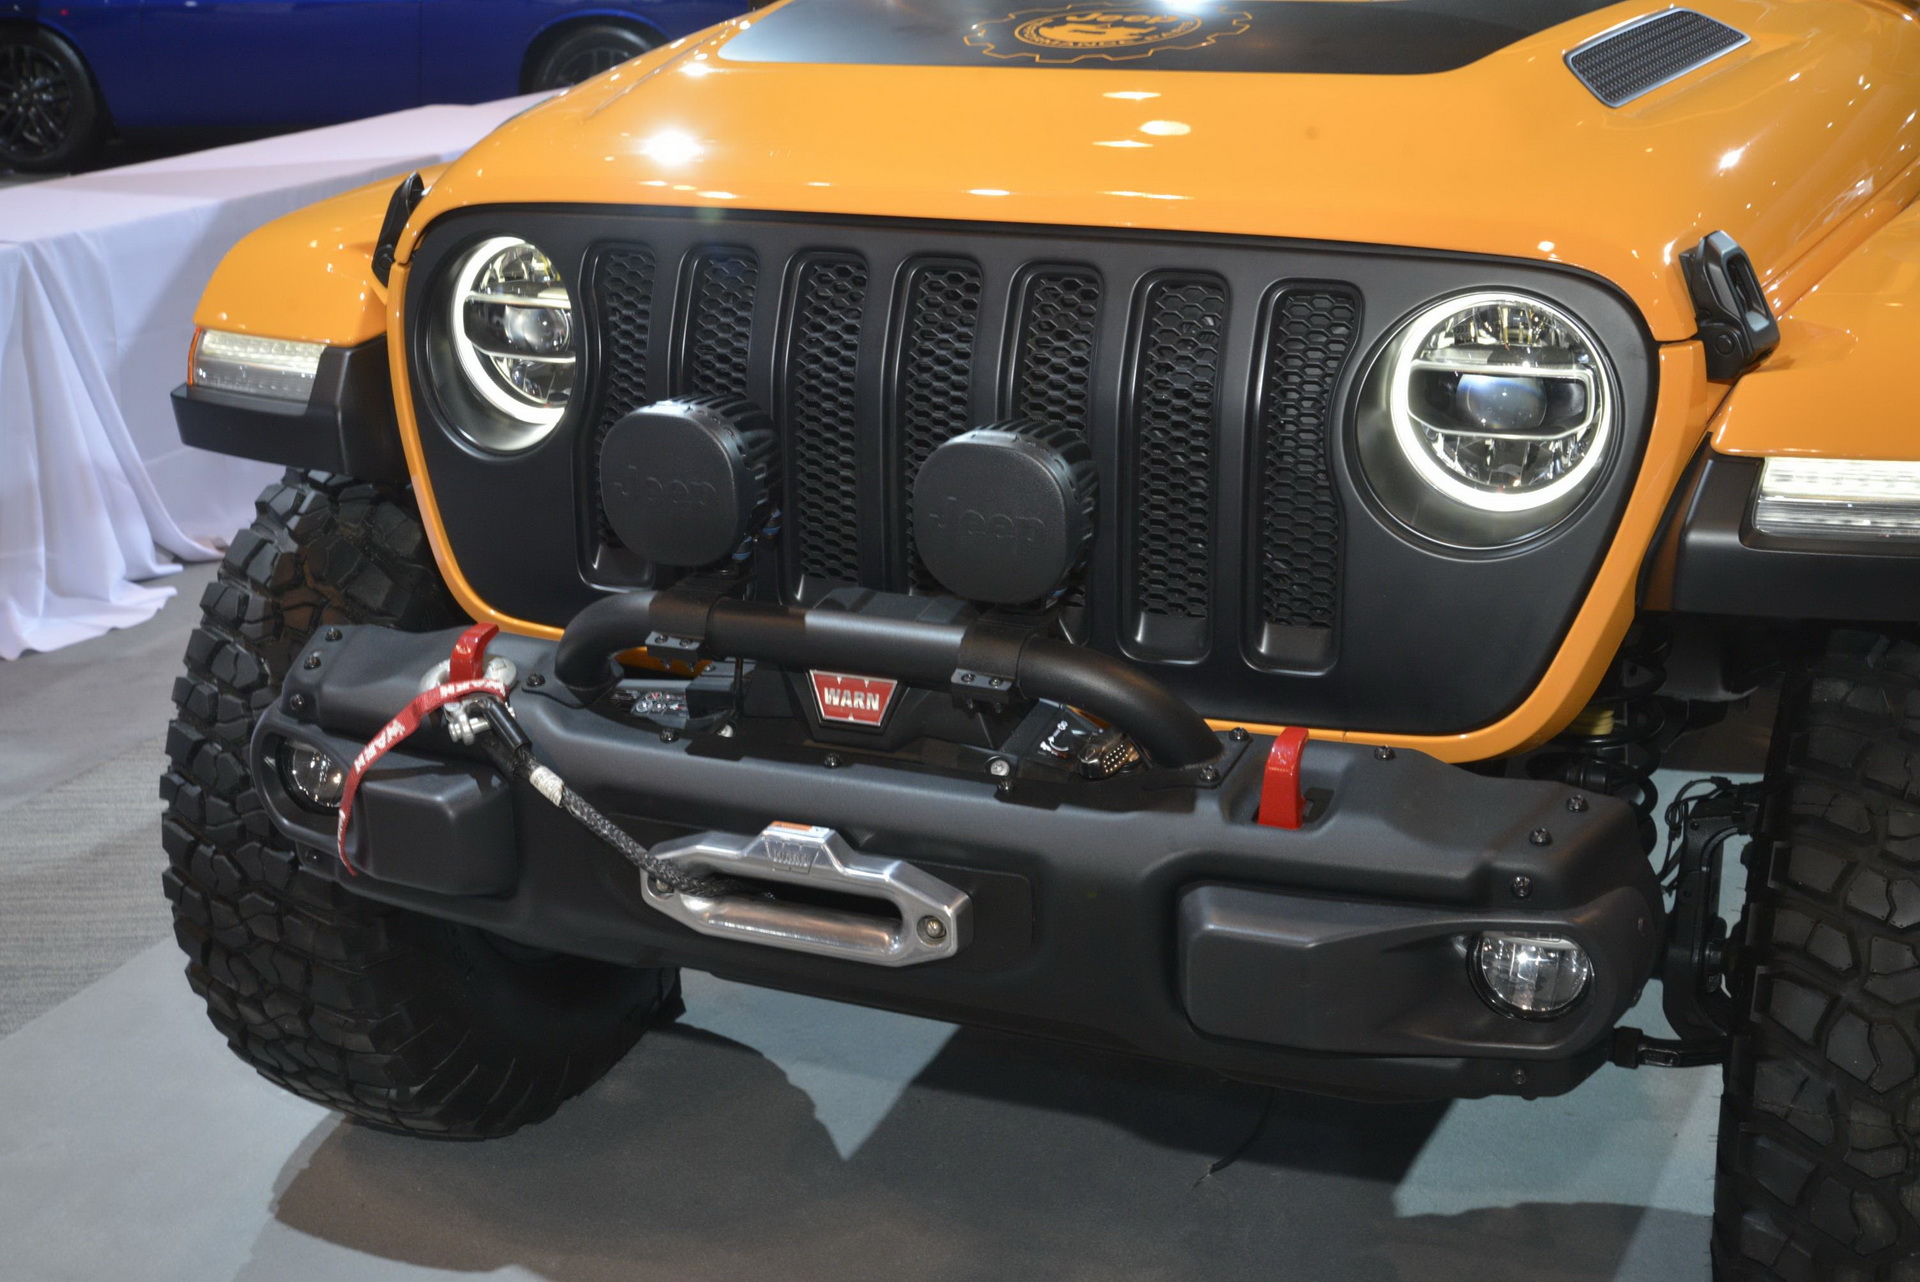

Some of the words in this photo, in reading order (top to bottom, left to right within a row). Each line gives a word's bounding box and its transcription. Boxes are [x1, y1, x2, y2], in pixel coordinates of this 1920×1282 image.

[1065, 12, 1179, 25] Jeep
[928, 495, 1046, 545] Jeep
[823, 687, 880, 711] WARN
[353, 719, 406, 774] WARN
